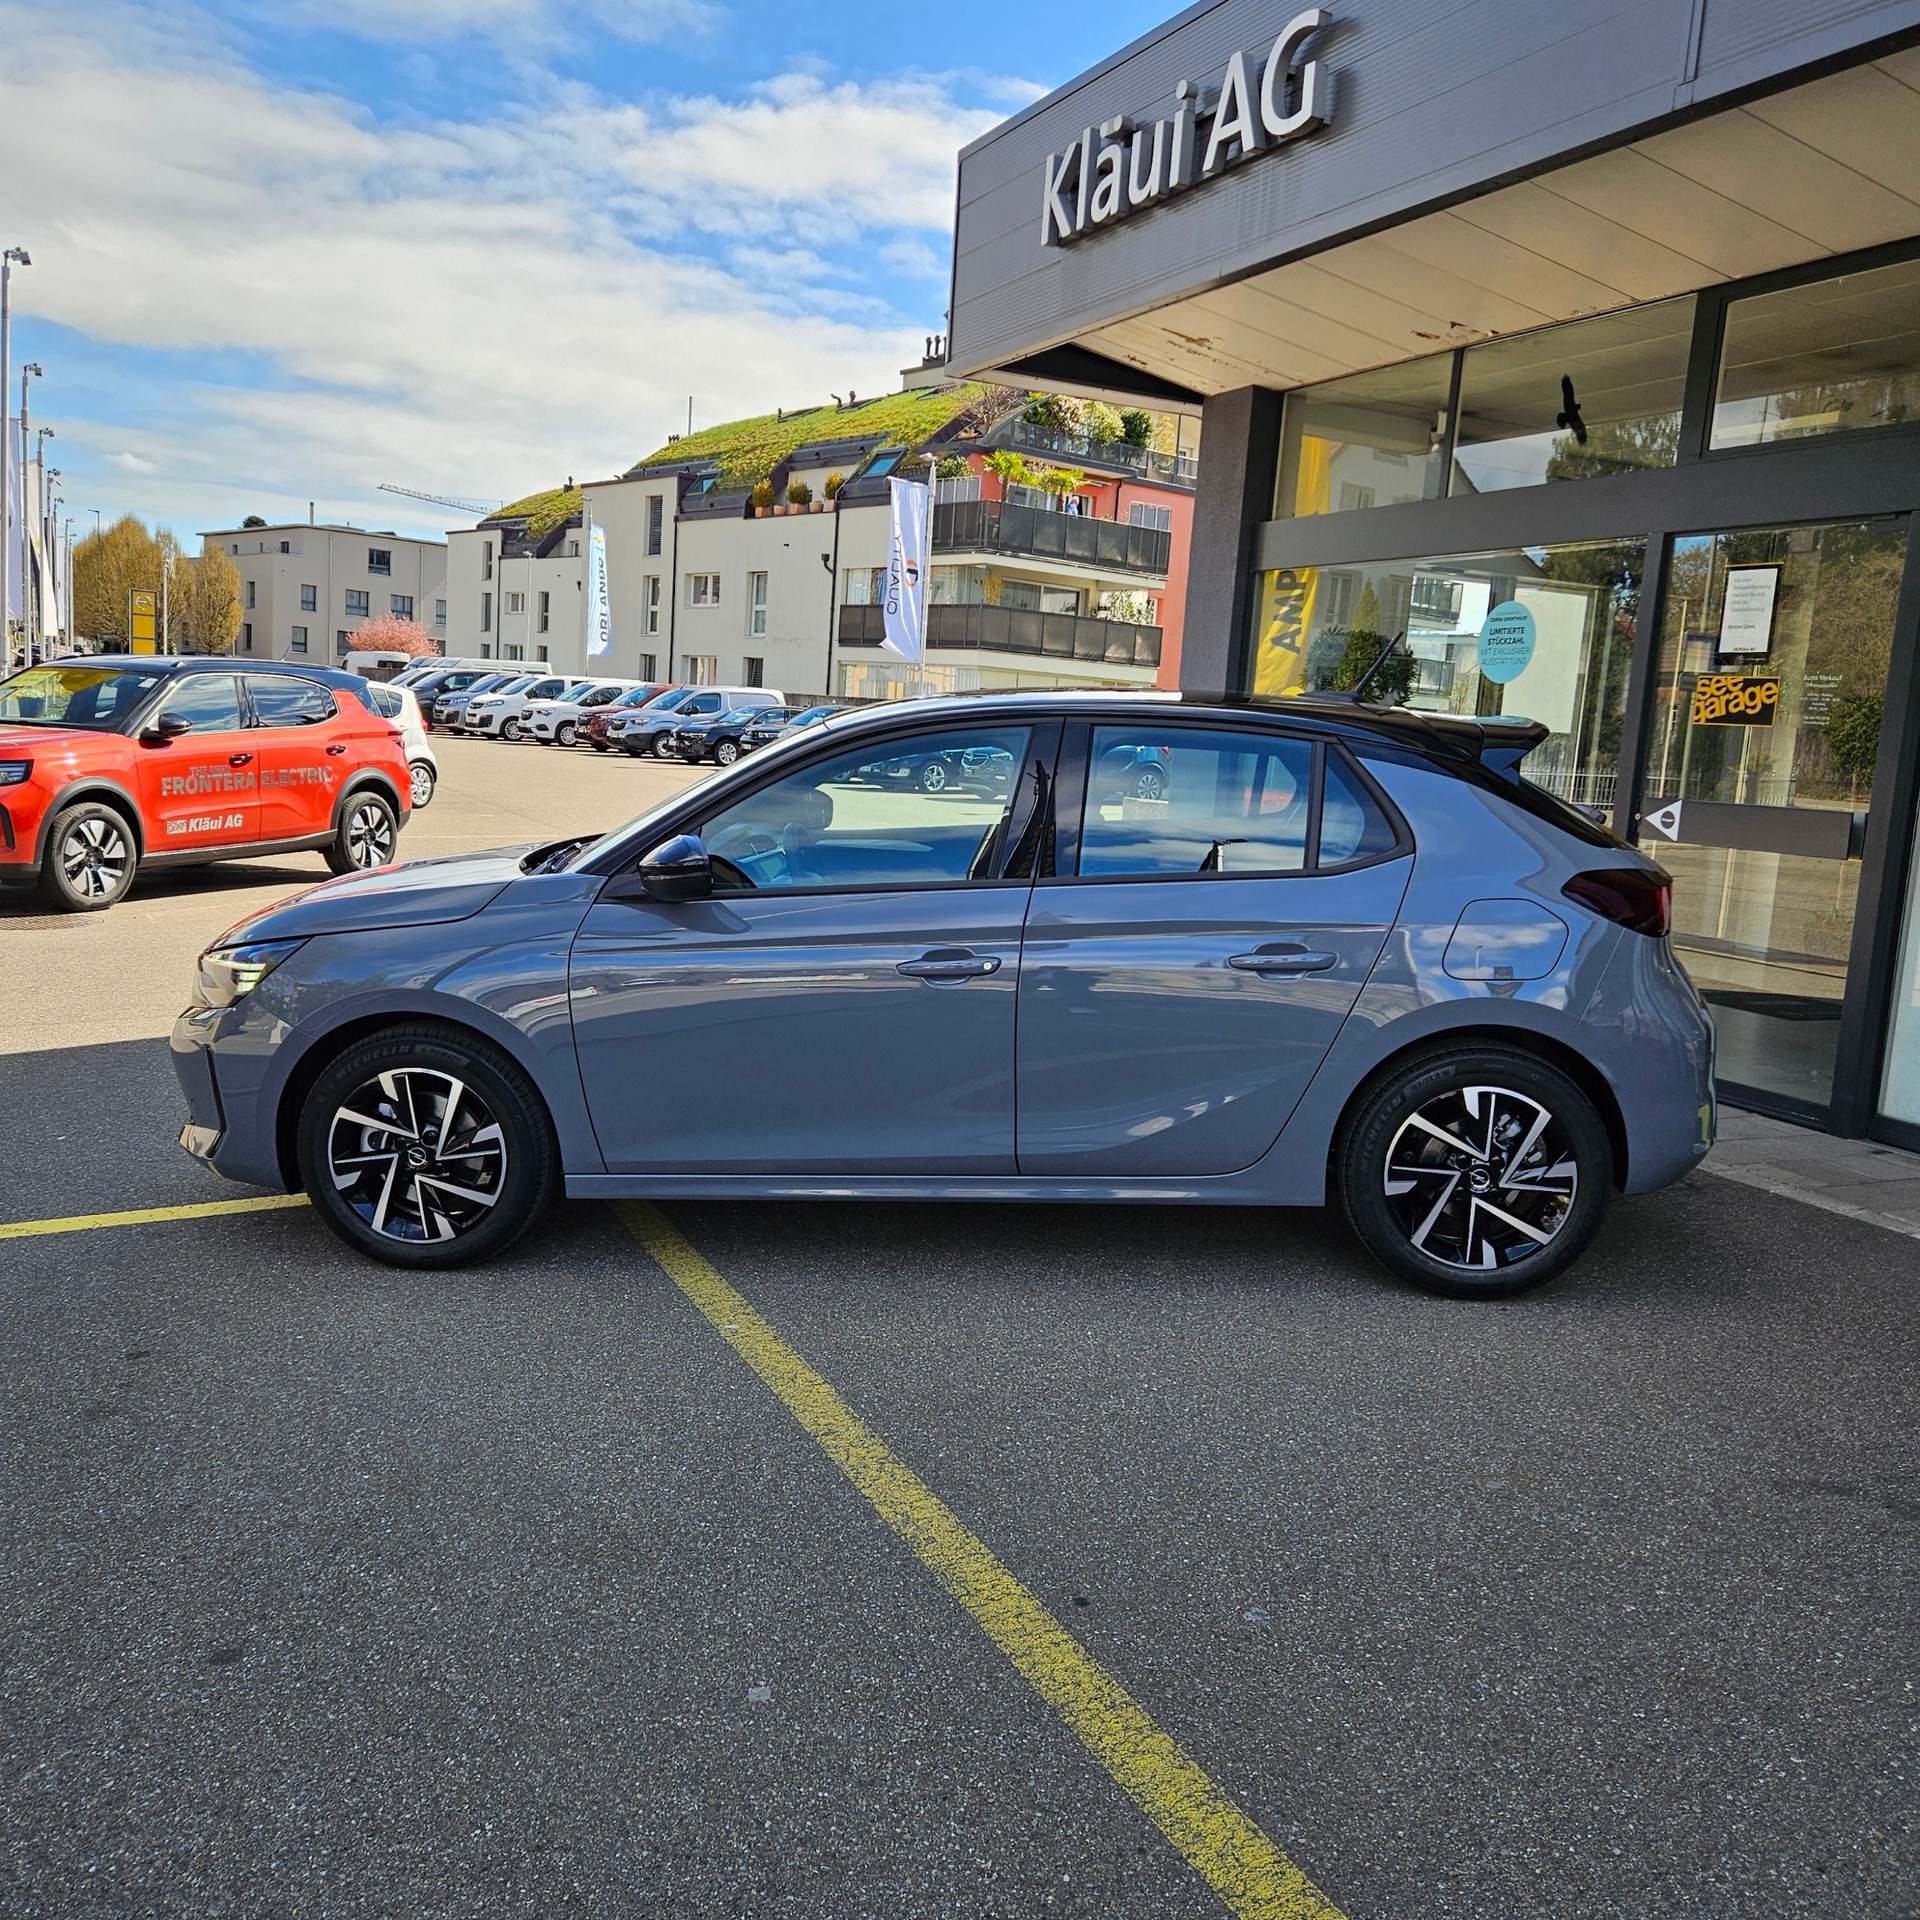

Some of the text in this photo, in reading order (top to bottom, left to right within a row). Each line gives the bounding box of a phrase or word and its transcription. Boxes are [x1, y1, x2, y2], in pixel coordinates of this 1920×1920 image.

[1040, 9, 1332, 246] Kläui AG
[886, 536, 902, 615] QUALITY
[598, 557, 608, 642] ORLANDO
[1487, 636, 1525, 646] STÜCKZAHL
[1490, 626, 1526, 636] LIMITIERTE
[1481, 647, 1531, 656] MIT EXKLUSIVER
[1481, 657, 1527, 666] AUSSTATTUNG
[1697, 676, 1744, 701] see
[1693, 682, 1778, 725] garage
[162, 766, 334, 796] FRONTERA ELECTRIC
[189, 765, 231, 777] THE NEW
[188, 814, 244, 833] Kläui AG
[335, 1044, 411, 1081] MICHELIN
